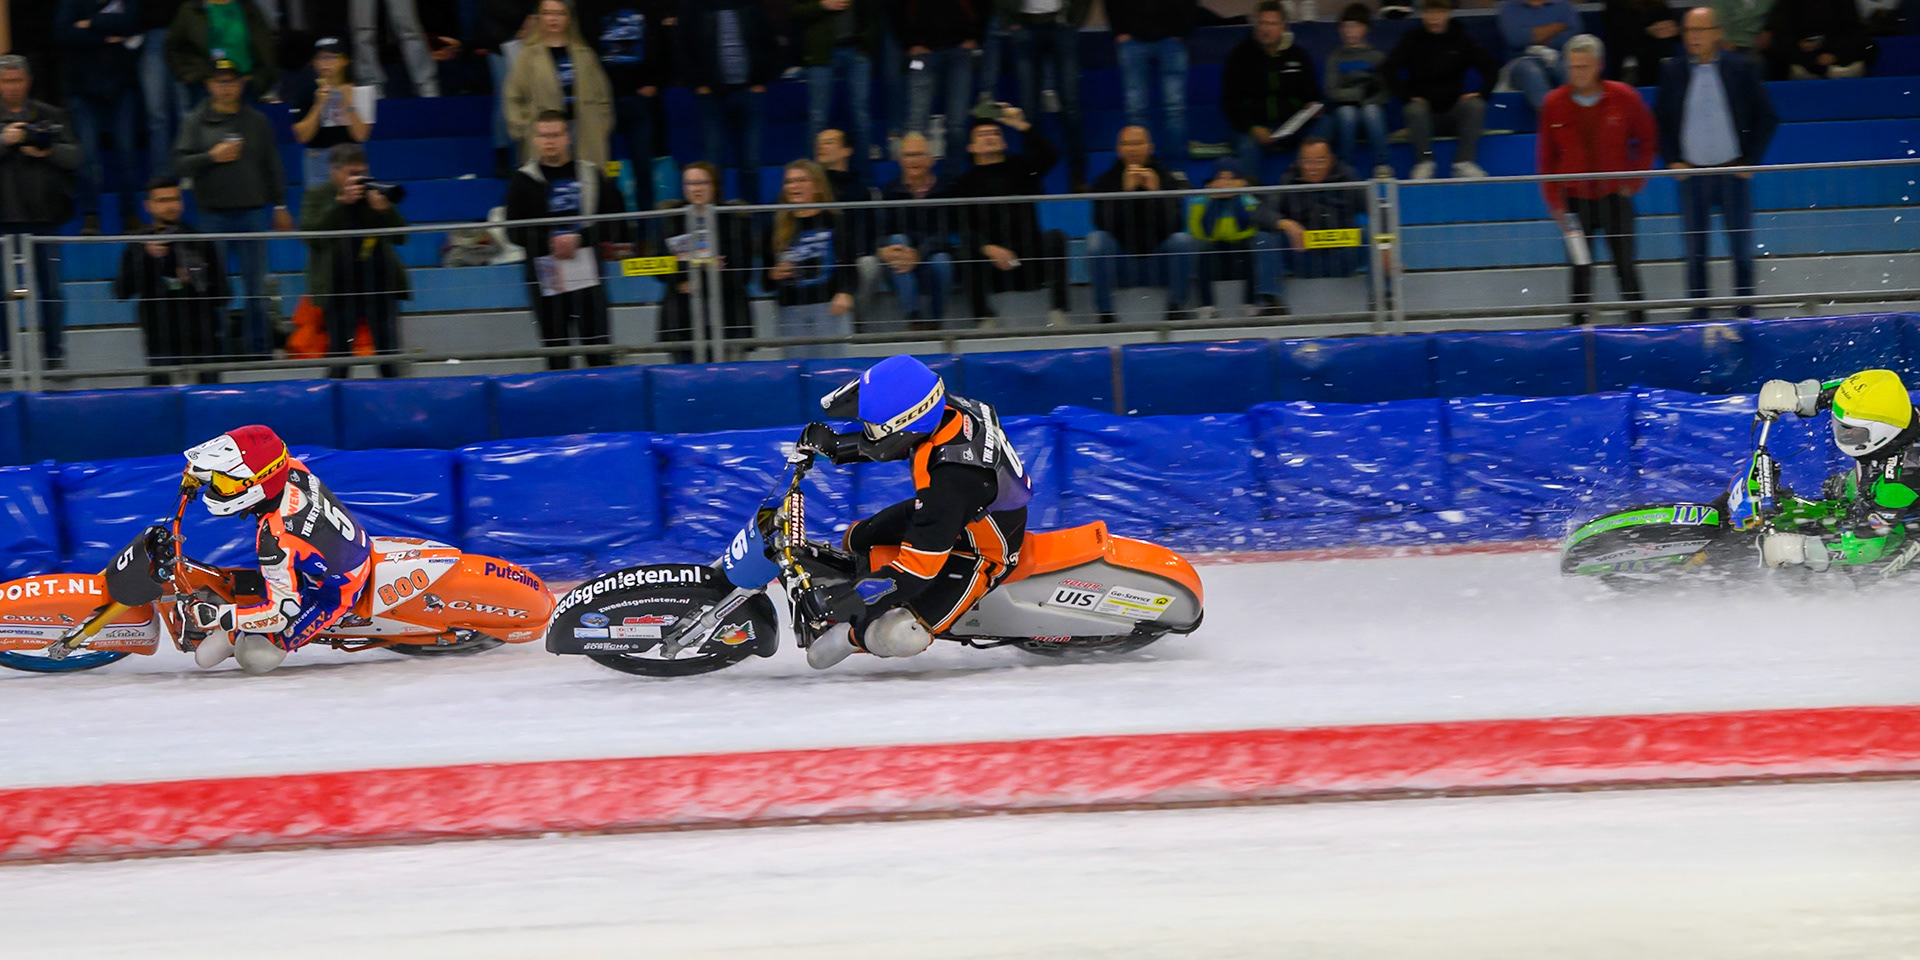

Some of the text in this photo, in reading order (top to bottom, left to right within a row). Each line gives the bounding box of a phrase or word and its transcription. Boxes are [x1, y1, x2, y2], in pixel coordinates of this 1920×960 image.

[894, 385, 945, 428] SCOTT
[323, 497, 356, 542] 5
[791, 492, 800, 547] RENTHAL
[1670, 505, 1716, 526] ILV
[301, 520, 315, 538] THE
[731, 528, 749, 561] 6
[116, 545, 134, 571] 5
[378, 569, 429, 606] 800
[485, 562, 540, 591] Putoline
[447, 600, 529, 620] C.W.V.
[598, 597, 690, 613] zweedsgenieten.nl
[1055, 590, 1095, 606] UIS
[2, 614, 54, 622] C.W.V.
